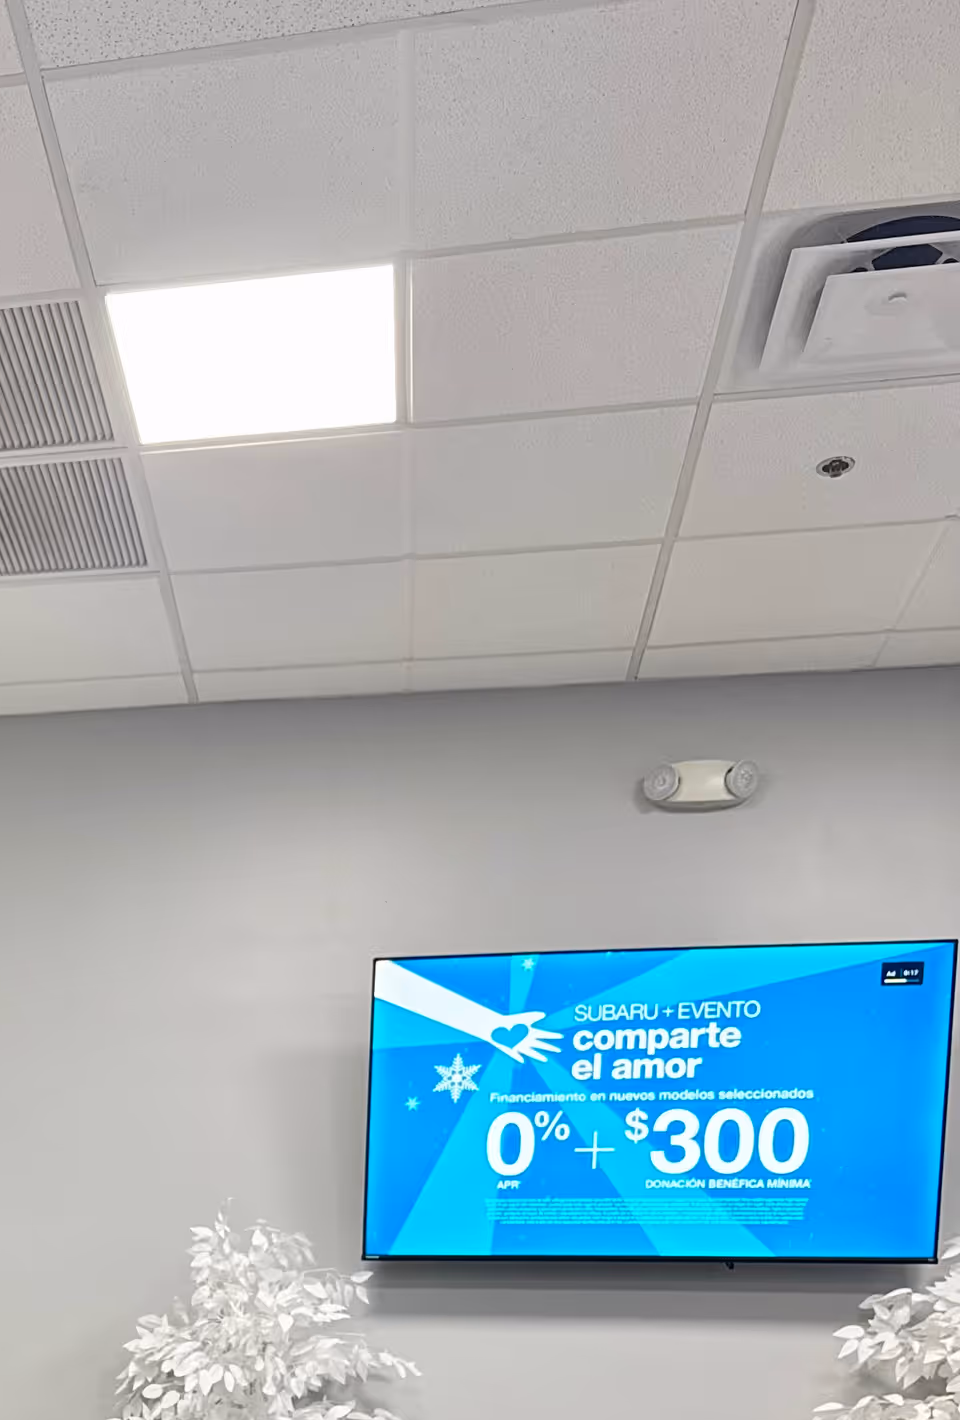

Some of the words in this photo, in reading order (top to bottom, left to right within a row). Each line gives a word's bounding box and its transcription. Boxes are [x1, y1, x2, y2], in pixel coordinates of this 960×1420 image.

[574, 1003, 658, 1022] SUBARU
[677, 1000, 761, 1019] EVENTO
[573, 1021, 742, 1056] comparte
[571, 1052, 602, 1081] el
[611, 1056, 703, 1080] amor
[489, 1091, 586, 1103] Financiamiento
[590, 1092, 606, 1101] en
[609, 1091, 655, 1102] nuevos
[659, 1089, 714, 1100] modelos
[718, 1087, 814, 1100] seleccionados
[624, 1106, 810, 1175] $300
[645, 1177, 706, 1189] DONACIÓN
[708, 1177, 765, 1189] BENÉFICA
